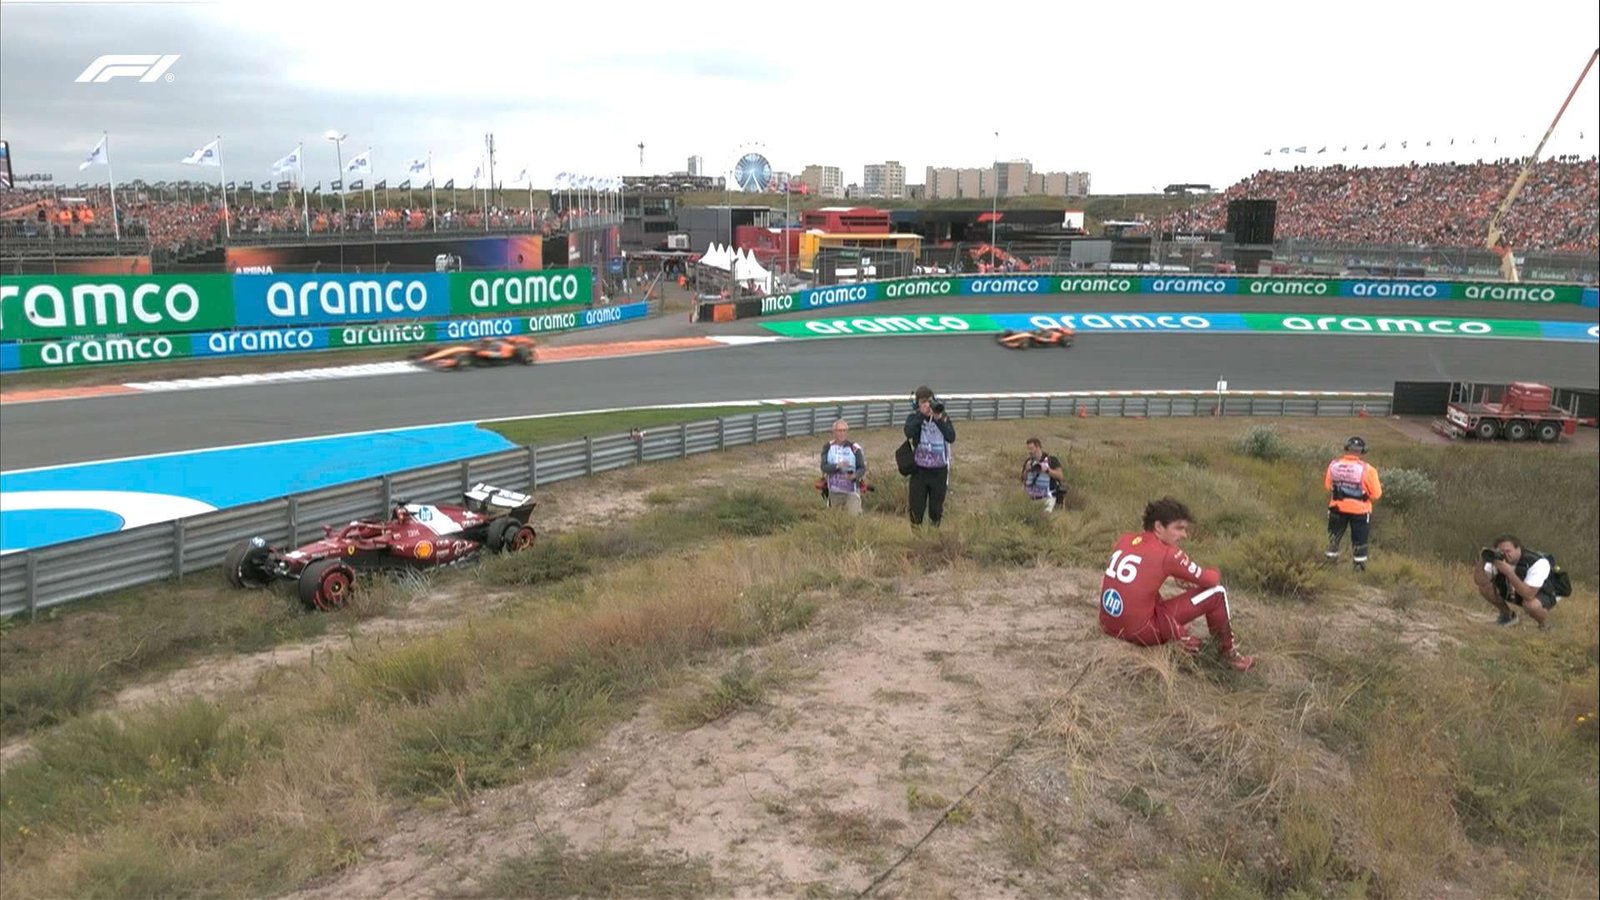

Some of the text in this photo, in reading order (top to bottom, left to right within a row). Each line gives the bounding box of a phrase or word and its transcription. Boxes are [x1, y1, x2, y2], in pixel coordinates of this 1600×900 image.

[469, 274, 578, 306] aramco
[886, 280, 951, 297] aramco
[971, 277, 1039, 292] aramco
[1060, 277, 1130, 293] aramco
[1152, 279, 1226, 293] aramco
[1250, 281, 1327, 295] aramco
[1353, 282, 1437, 297] aramco
[1465, 286, 1556, 302] aramco
[266, 280, 428, 316] aramco
[809, 286, 867, 306] aramco
[529, 312, 576, 332] aramco
[586, 306, 622, 324] aramco
[1029, 314, 1211, 329] aramco
[342, 325, 425, 345] aramco
[447, 316, 513, 339] aramco
[805, 315, 970, 336] aramco
[1282, 317, 1492, 335] aramco
[41, 337, 172, 364] aramco
[208, 329, 313, 352] aramco
[1105, 550, 1142, 583] 16
[1104, 589, 1122, 616] hp
